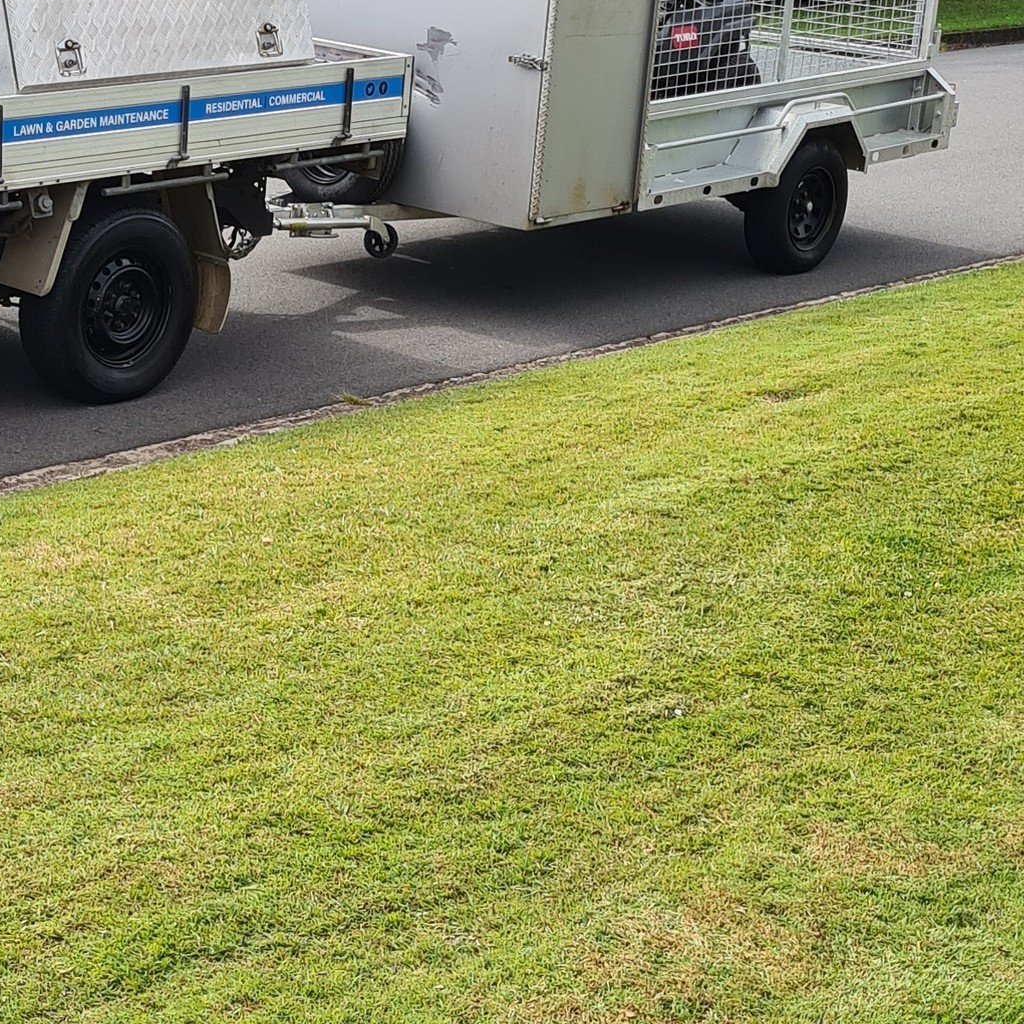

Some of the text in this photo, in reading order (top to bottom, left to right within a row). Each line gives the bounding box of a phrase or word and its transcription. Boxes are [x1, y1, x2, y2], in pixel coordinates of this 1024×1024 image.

[675, 32, 698, 42] TORO
[205, 90, 326, 114] RESIDENTIAL COMMERCIAL
[13, 108, 169, 137] LAWN & GARDEN MAINTENANCE
